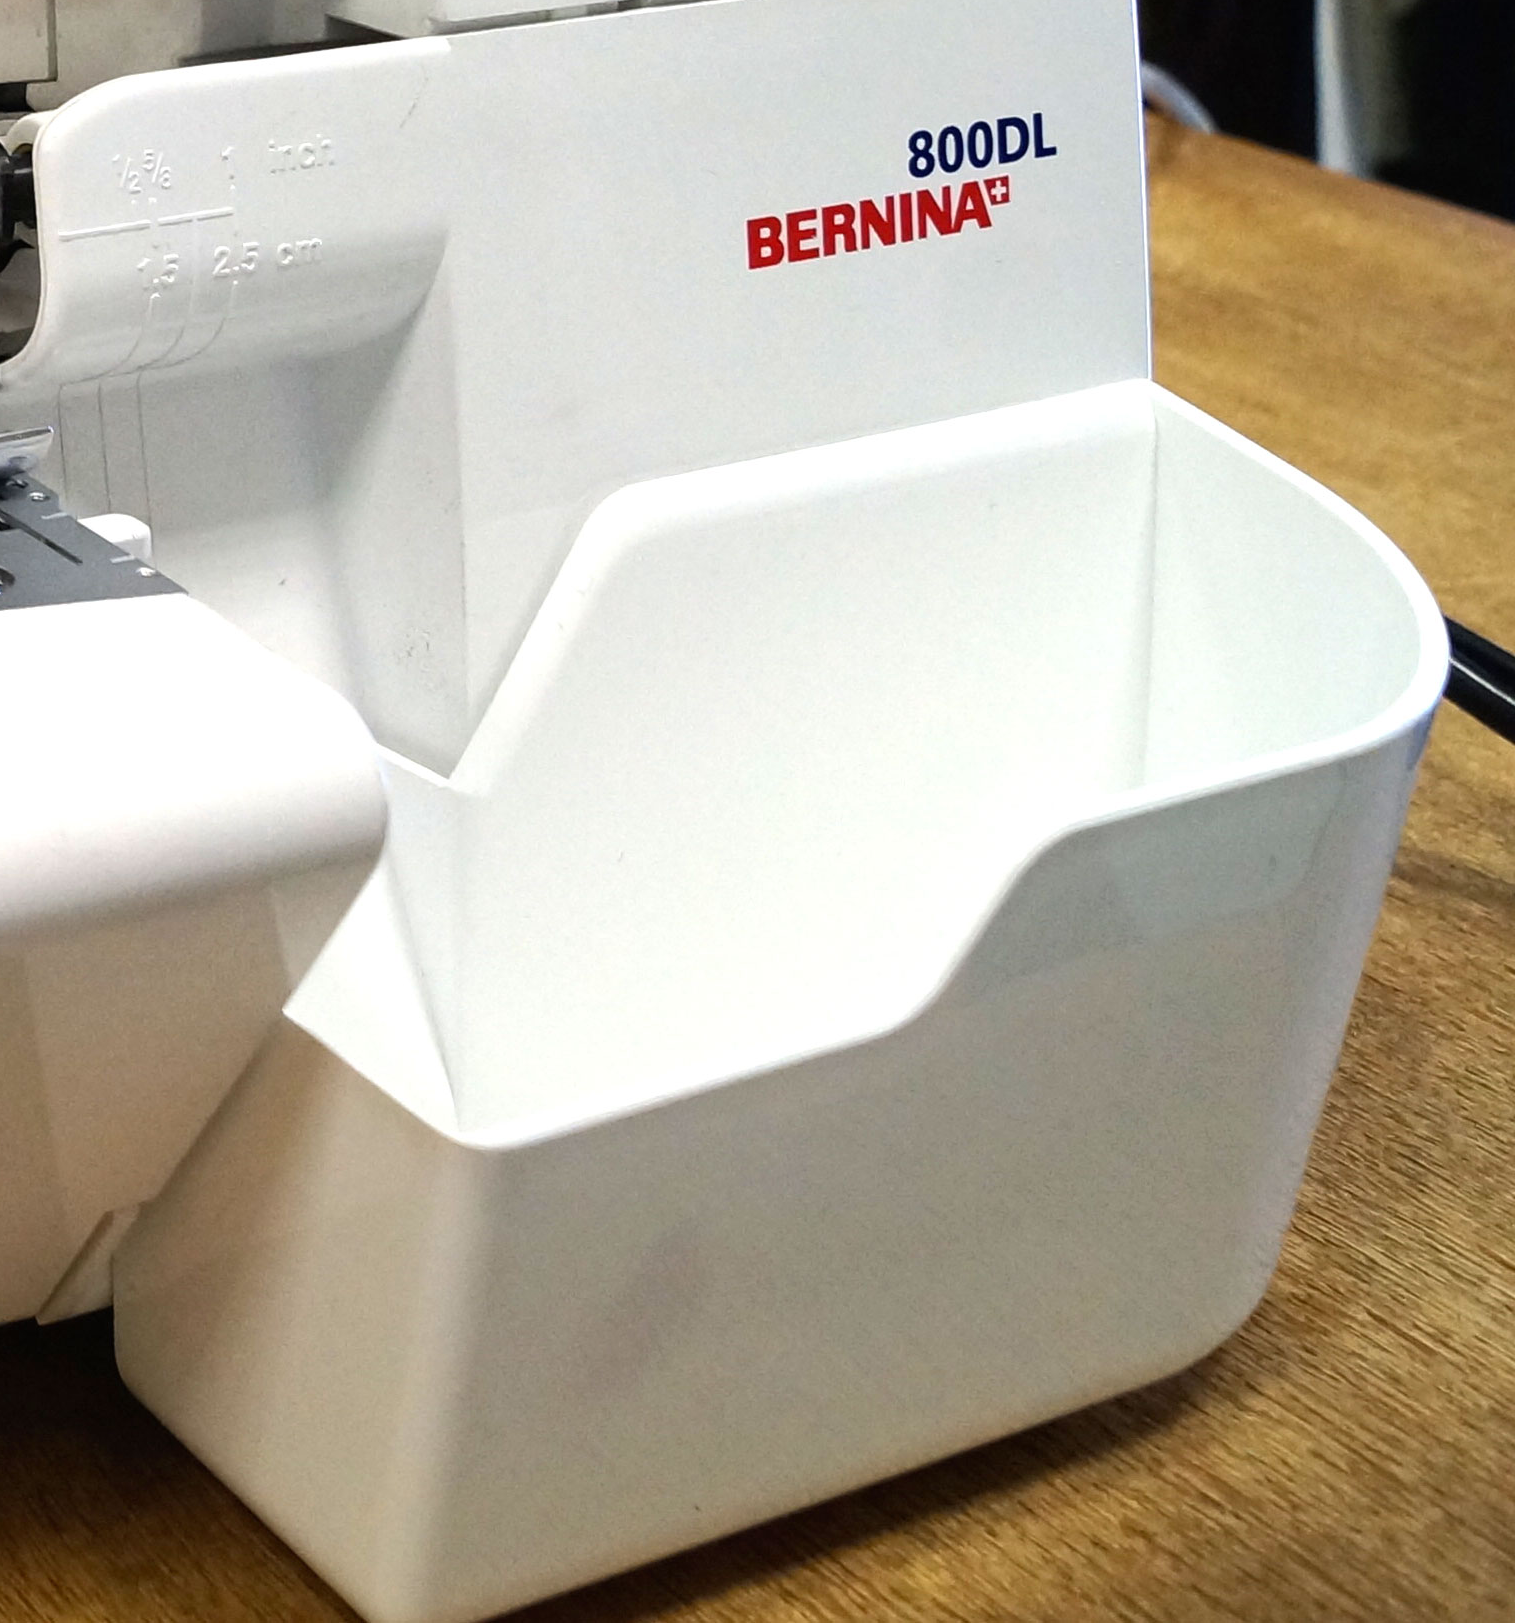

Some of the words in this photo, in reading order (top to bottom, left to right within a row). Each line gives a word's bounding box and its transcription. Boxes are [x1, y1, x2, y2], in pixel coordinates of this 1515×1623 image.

[907, 112, 1058, 178] 800DL
[746, 179, 993, 271] BERNINA
[212, 242, 260, 279] 2.5
